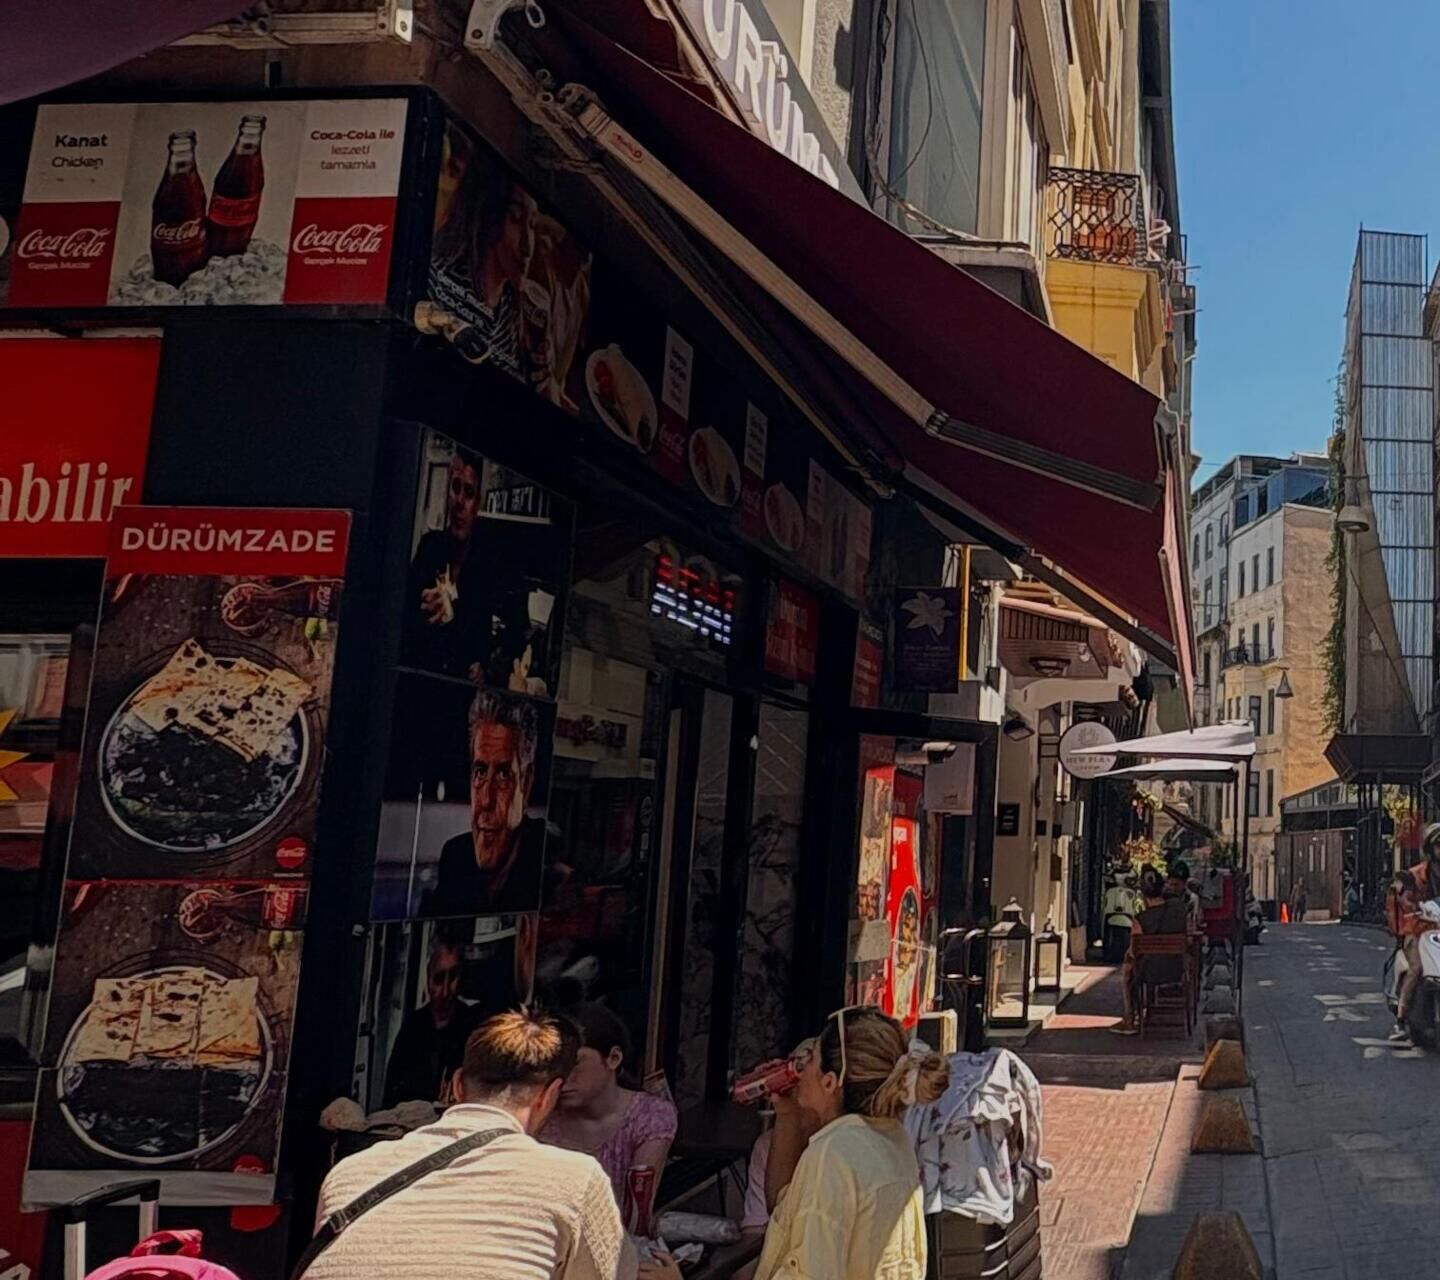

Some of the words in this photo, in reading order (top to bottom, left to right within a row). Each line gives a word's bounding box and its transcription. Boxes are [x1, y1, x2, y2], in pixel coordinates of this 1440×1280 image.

[55, 134, 108, 149] Kanat
[311, 130, 376, 141] Coca-Cola
[51, 156, 104, 170] Chicken
[153, 218, 202, 241] Coca-Cola
[292, 223, 388, 254] Coca-Cola
[17, 226, 111, 259] Coca-Cola
[121, 522, 337, 553] DÜRÜMZADE
